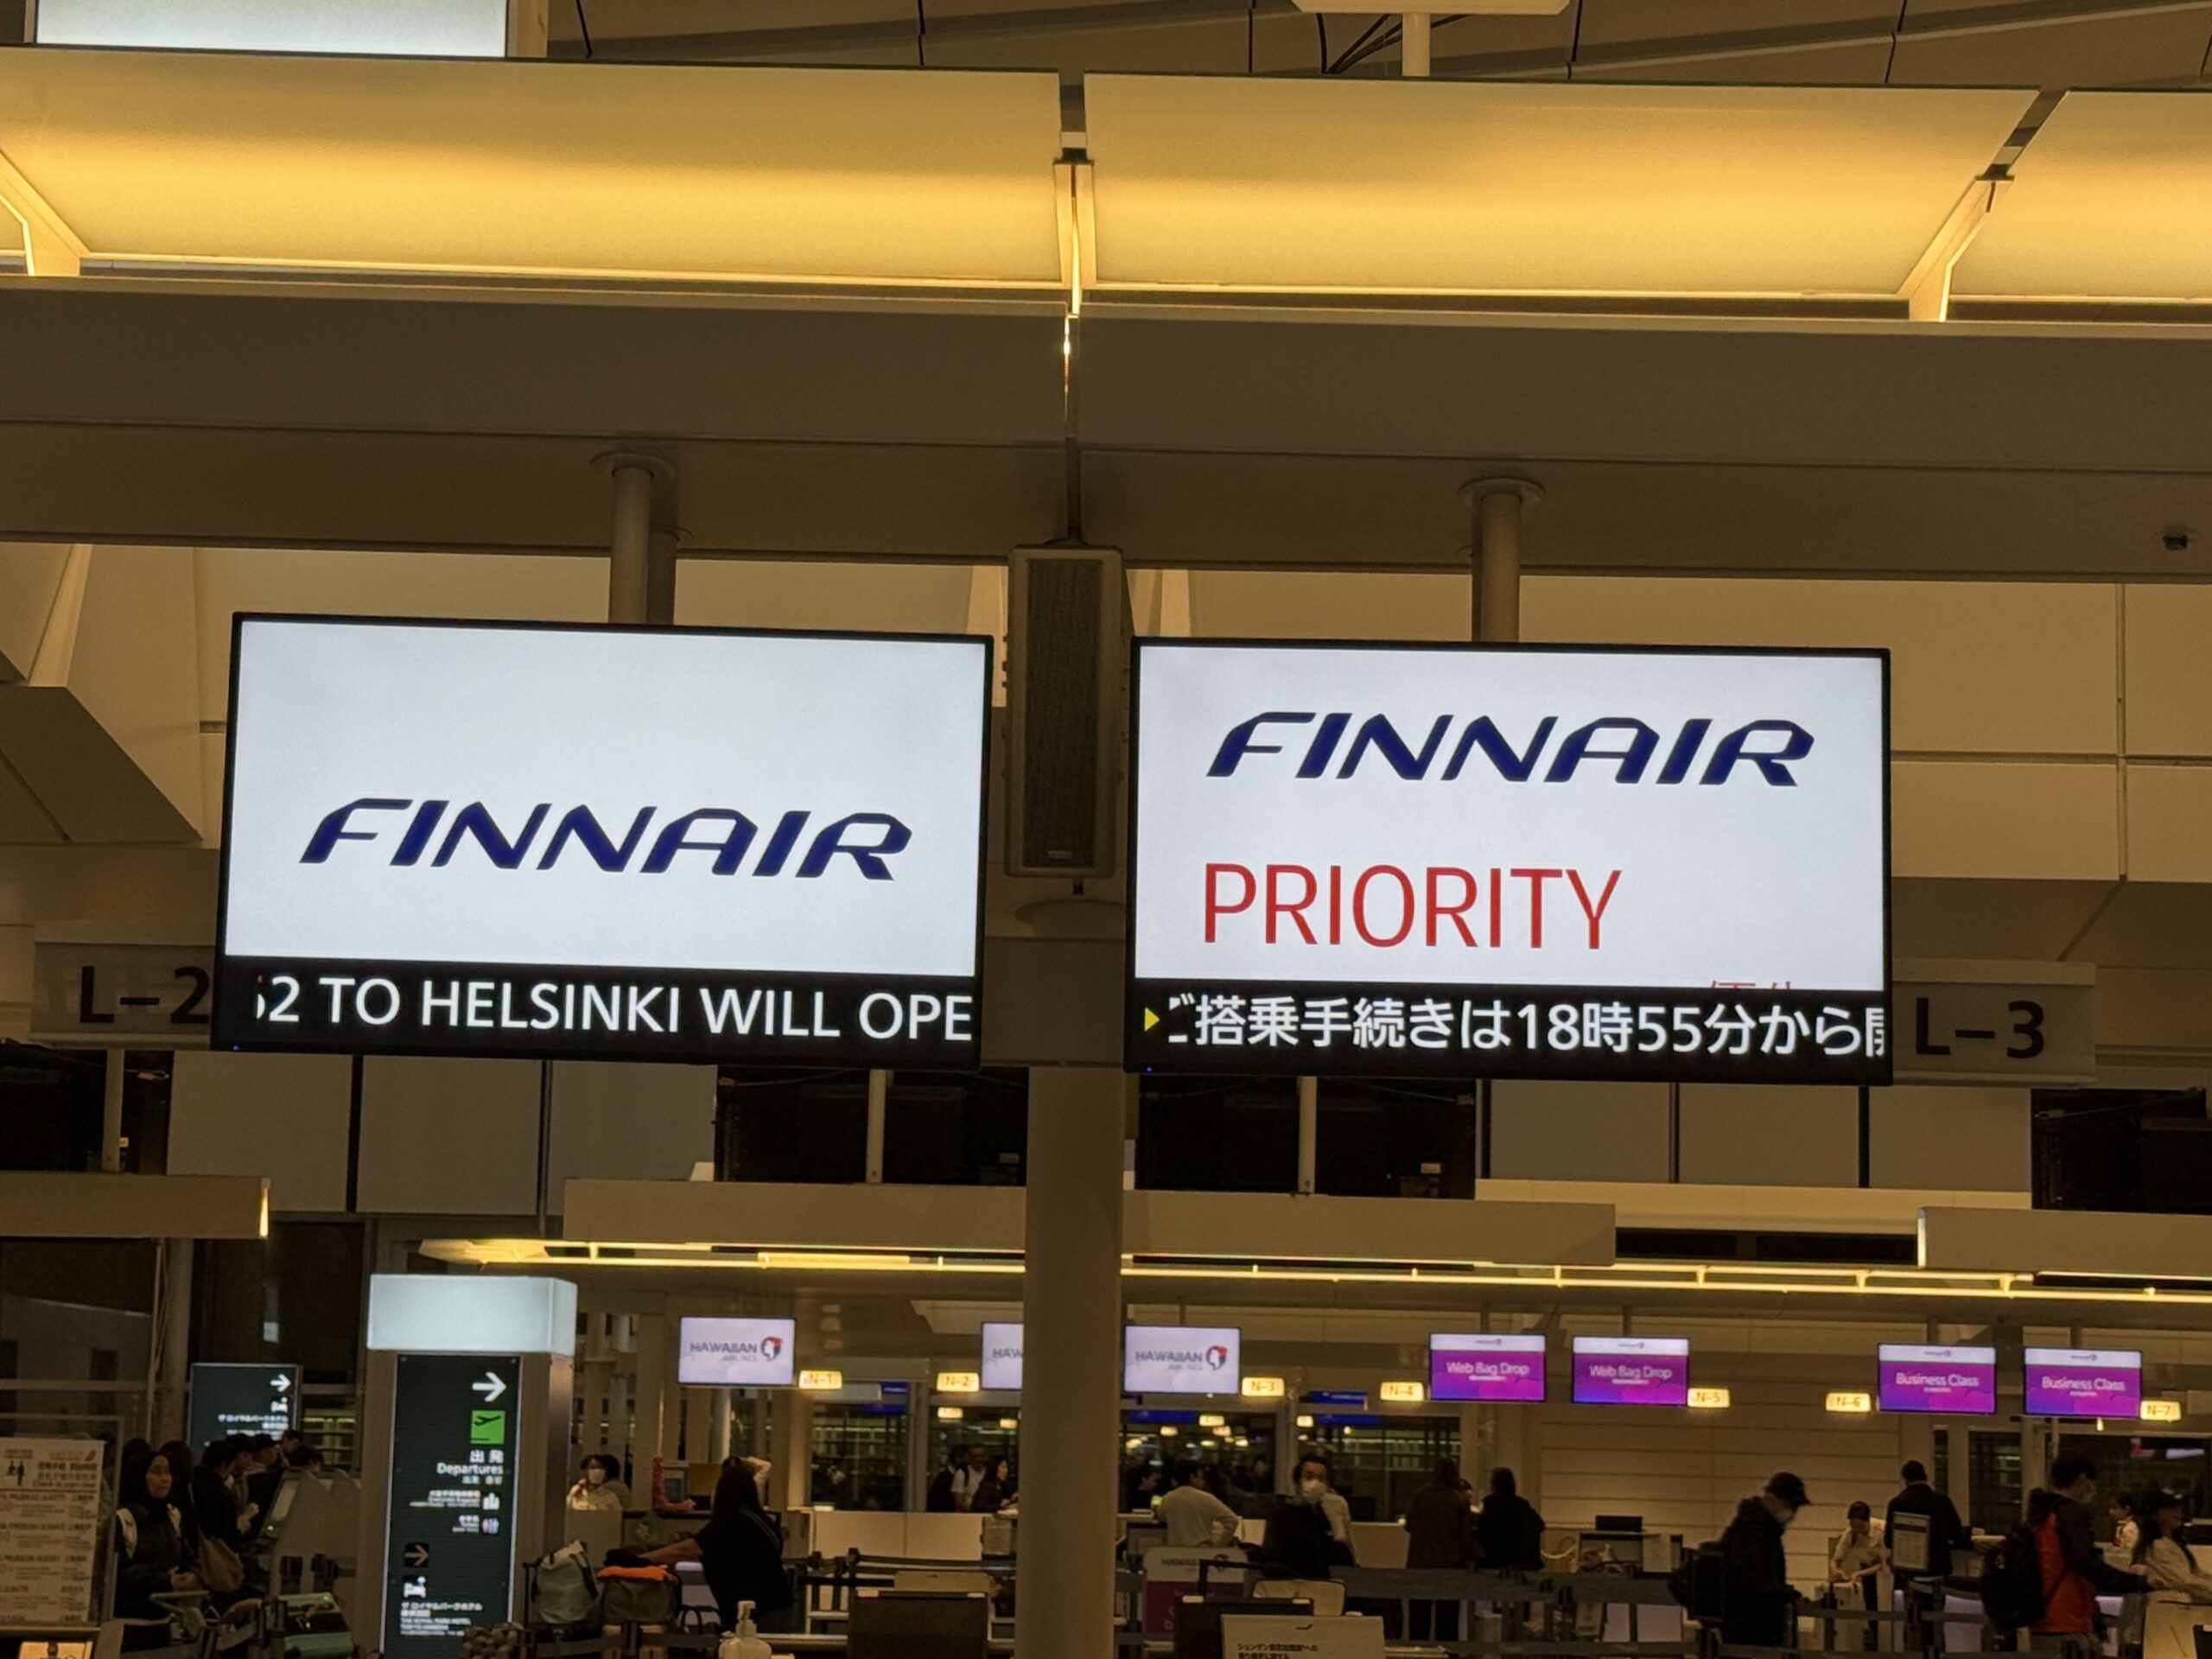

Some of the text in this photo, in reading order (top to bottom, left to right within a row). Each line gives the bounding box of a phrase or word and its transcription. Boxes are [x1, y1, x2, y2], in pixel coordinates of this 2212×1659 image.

[1207, 712, 1815, 786] FINNAIR
[299, 798, 912, 880] FINNAIR
[1205, 862, 1623, 950] PRIORITY
[319, 977, 400, 1025] TO
[422, 980, 679, 1033] HELSINKI
[699, 988, 841, 1037] WILL
[859, 992, 973, 1041] OPE
[1916, 997, 2045, 1059] L-3
[1446, 1362, 1530, 1376] Web Bag Drop
[1589, 1365, 1674, 1380] Web Bag Drop
[1896, 1372, 1980, 1387] Business Class
[2042, 1376, 2126, 1391] Business Class
[436, 1462, 505, 1477] Departures
